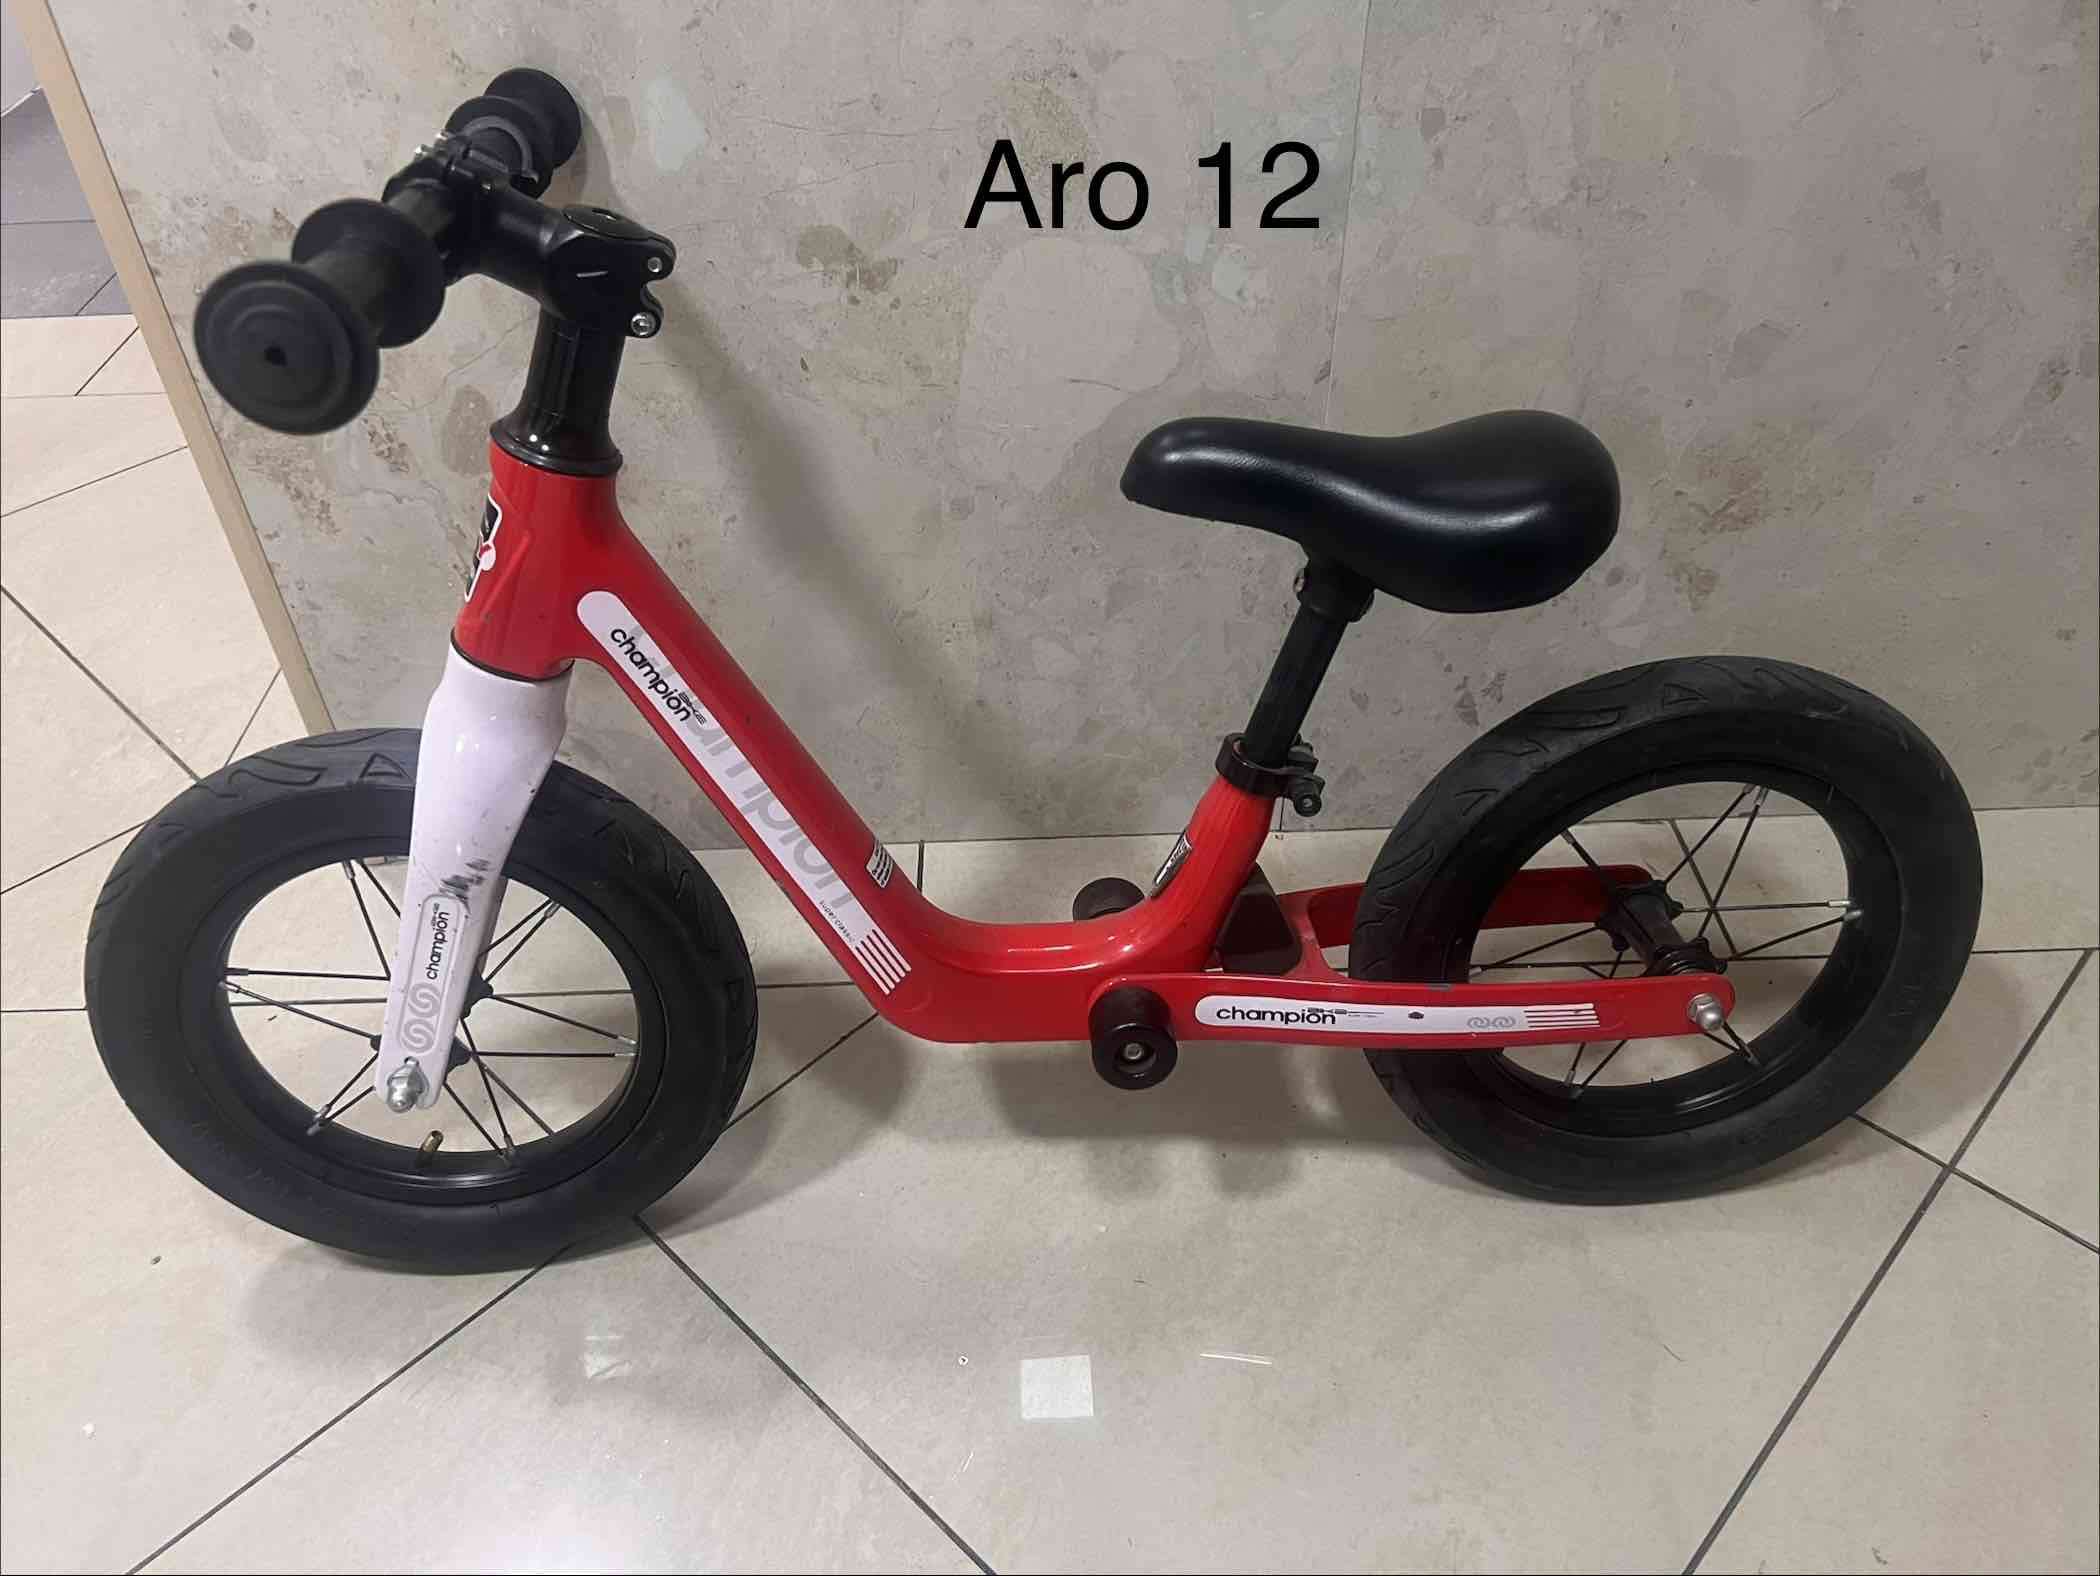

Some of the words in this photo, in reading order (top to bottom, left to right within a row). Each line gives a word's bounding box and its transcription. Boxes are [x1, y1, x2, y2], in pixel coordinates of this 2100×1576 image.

[611, 628, 692, 721] champion
[426, 911, 450, 980] champion
[1216, 1006, 1336, 1025] champion
